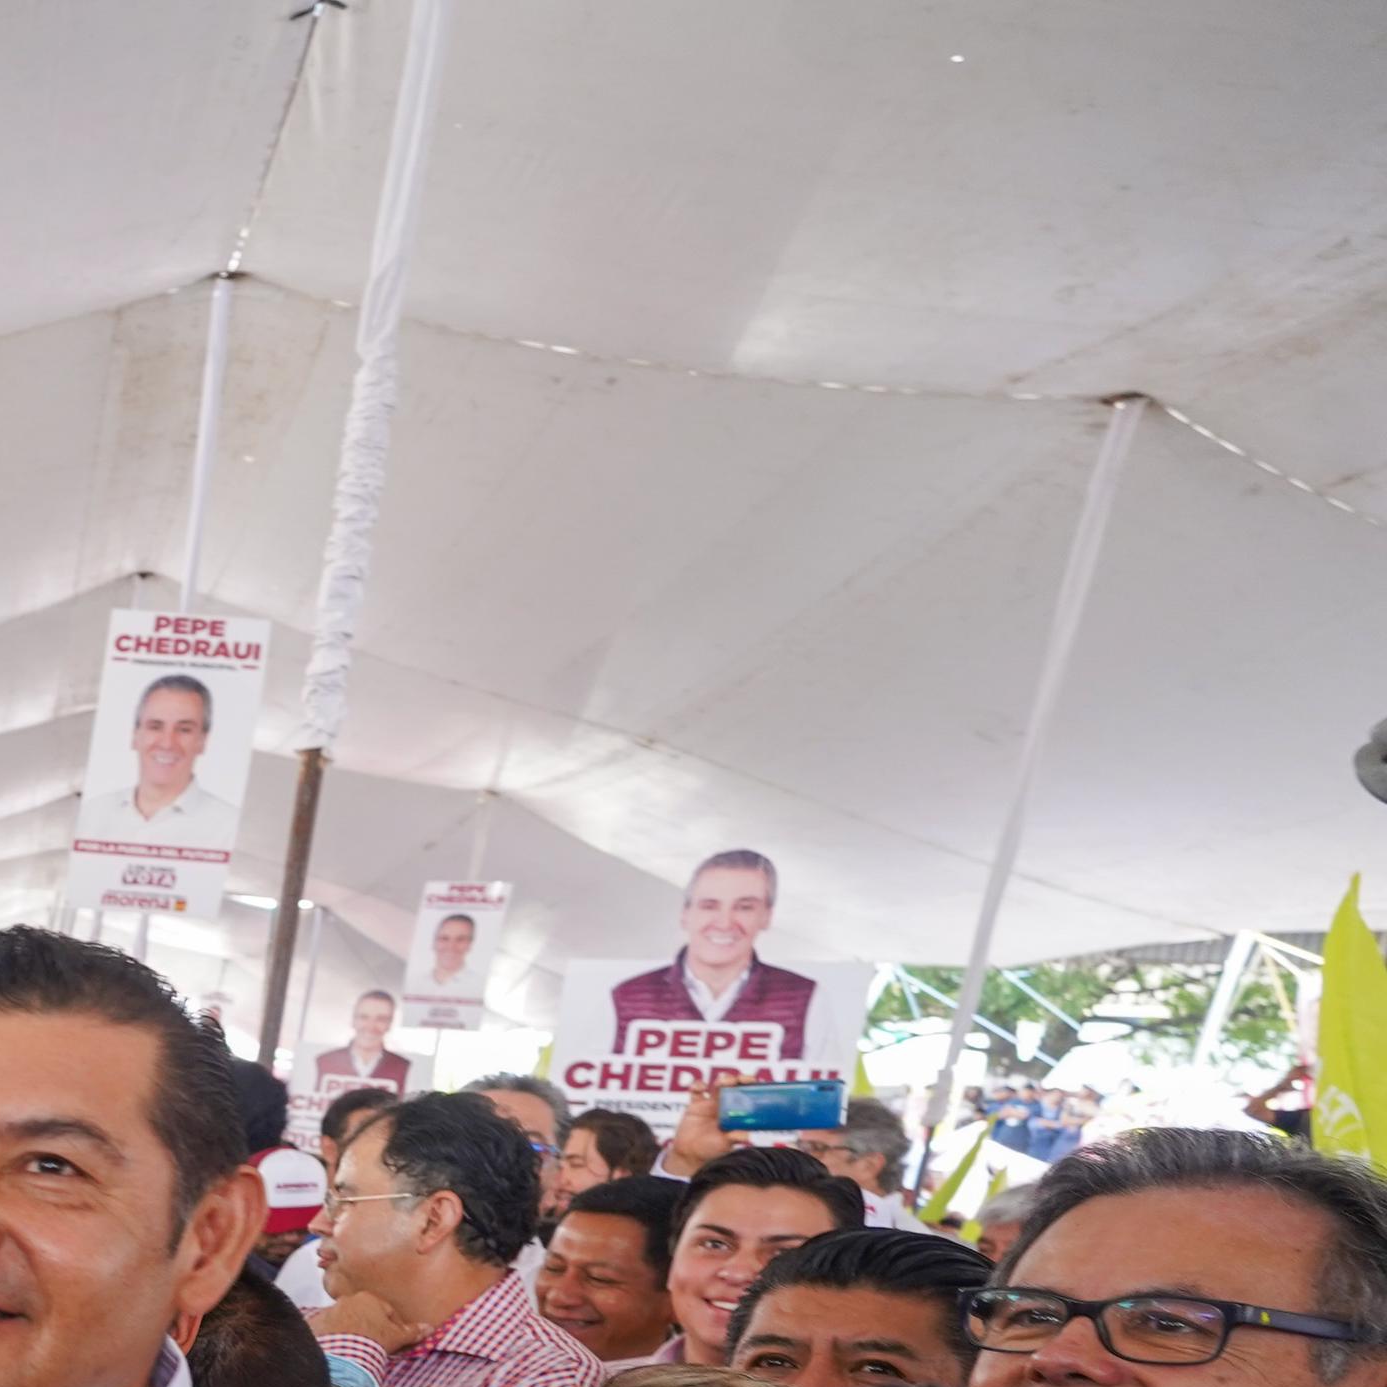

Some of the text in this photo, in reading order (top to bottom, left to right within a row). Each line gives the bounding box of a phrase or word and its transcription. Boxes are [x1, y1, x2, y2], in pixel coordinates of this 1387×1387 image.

[154, 615, 226, 637] PEPE
[114, 635, 262, 661] CHEDRAUI
[635, 1029, 771, 1060] PEPE
